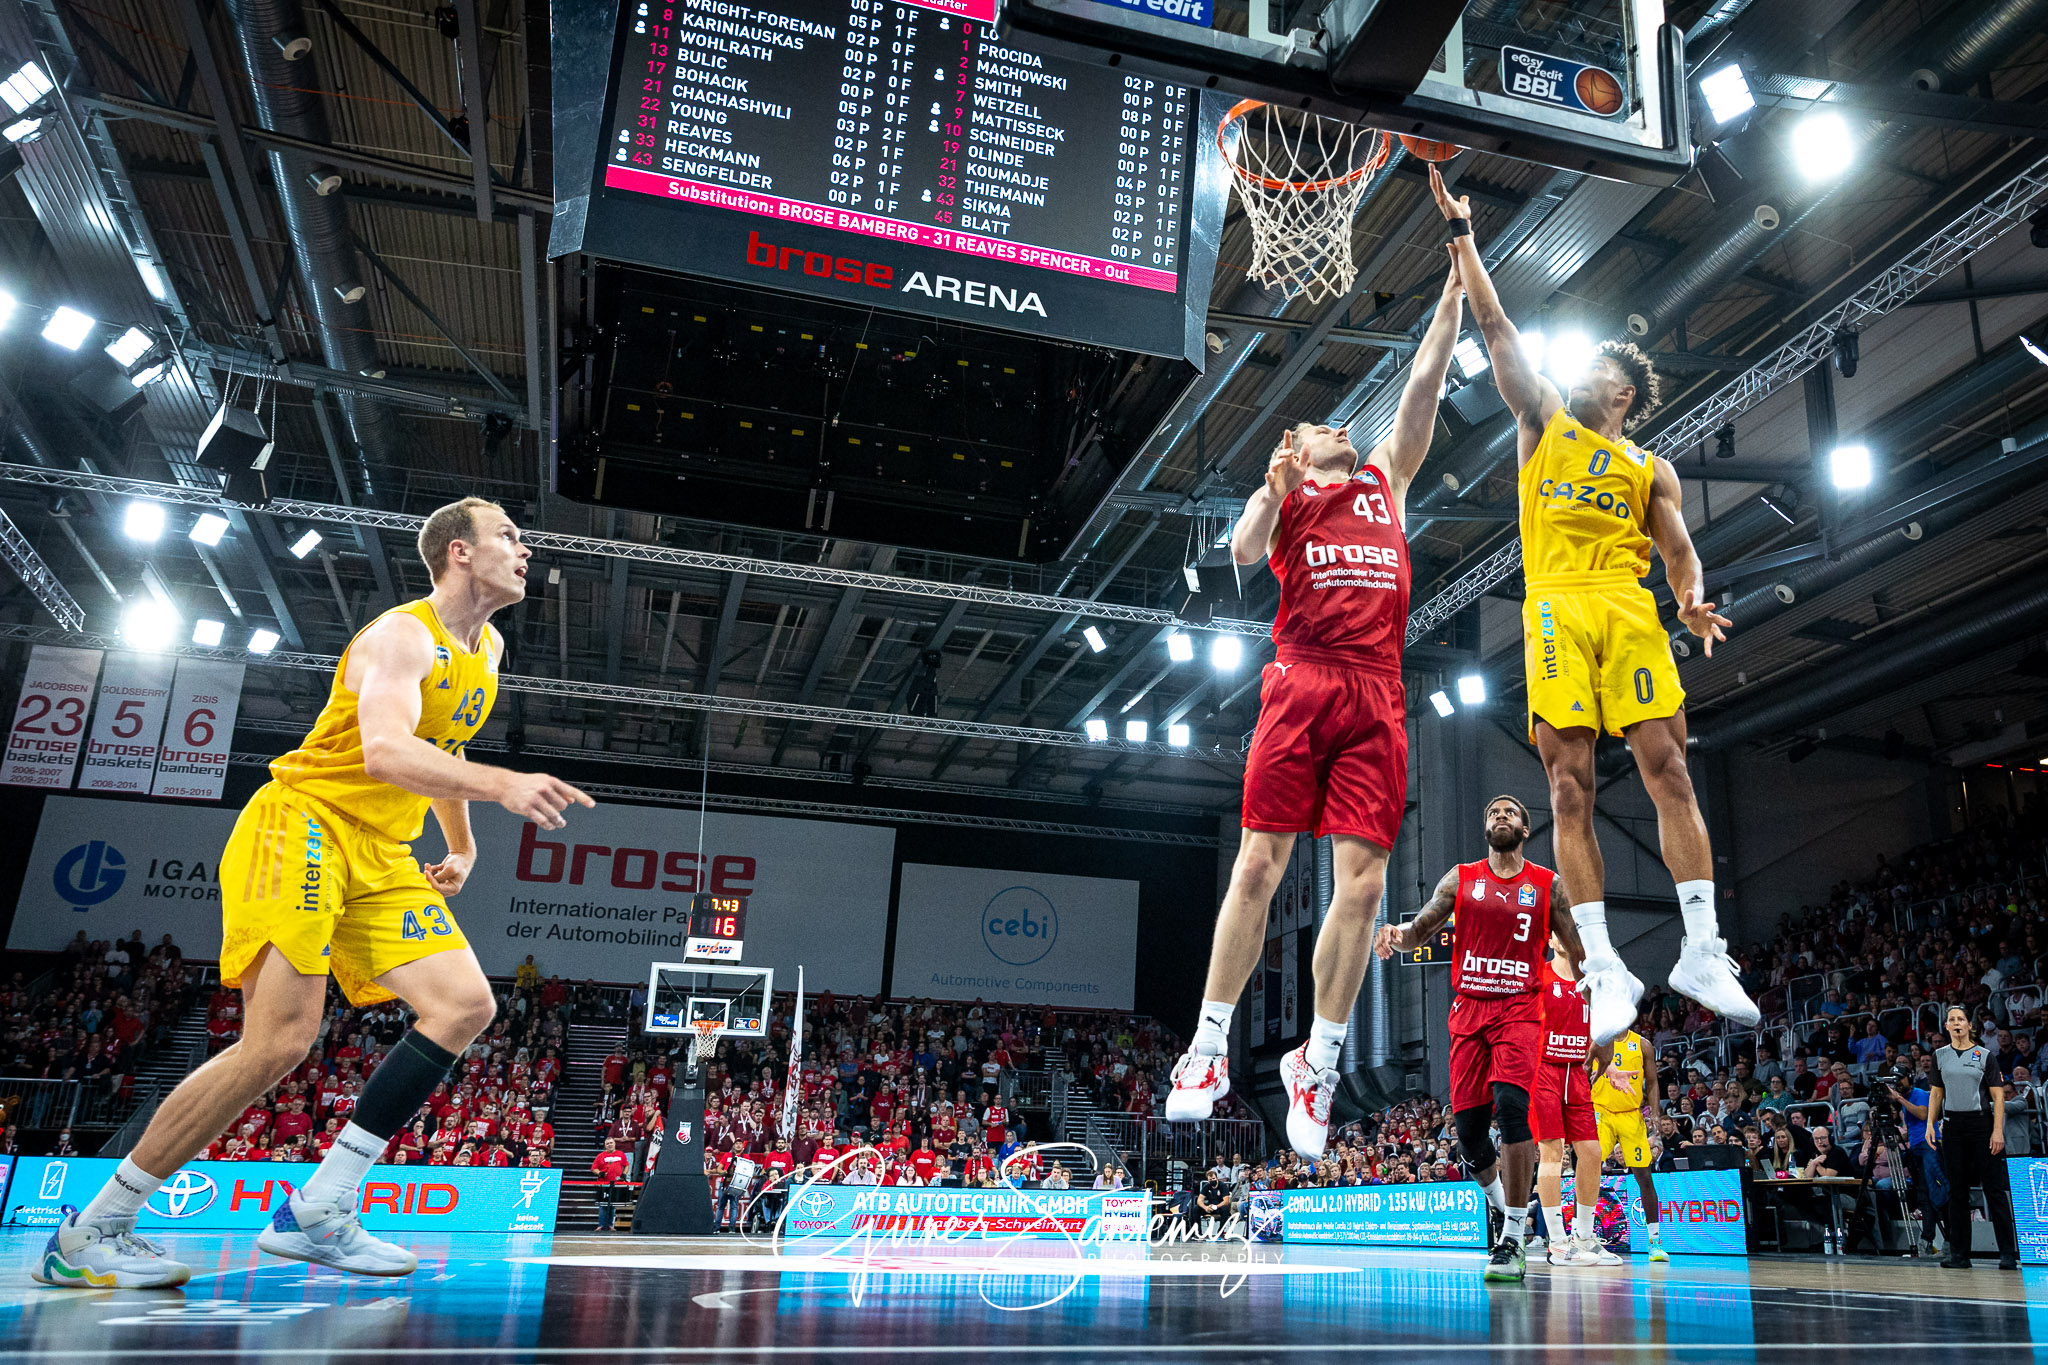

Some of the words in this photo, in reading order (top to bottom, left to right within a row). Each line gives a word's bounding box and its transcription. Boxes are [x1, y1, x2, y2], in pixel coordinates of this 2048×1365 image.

[664, 9, 672, 20] 8
[683, 13, 803, 49] KARINIAUSKAS
[686, 0, 835, 39] WRIGHT-FOREMAN
[964, 23, 971, 34] 0
[651, 42, 668, 56] 13
[678, 48, 727, 69] BULIC
[653, 25, 668, 38] 11
[681, 30, 772, 61] WOHLRATH
[963, 40, 968, 51] 1
[979, 44, 1042, 68] PROCIDA
[648, 61, 666, 74] 17
[676, 66, 748, 92] BOHACIK
[958, 74, 966, 85] 3
[975, 78, 1021, 97] SMITH
[960, 57, 968, 68] 2
[978, 60, 1066, 90] MACHOWSKI
[1527, 66, 1564, 81] Credit
[643, 78, 661, 92] 21
[673, 85, 791, 119] CHACHASHVILI
[1512, 73, 1564, 102] BBL
[641, 96, 660, 111] 22
[671, 102, 727, 124] YOUNG
[957, 90, 965, 101] 7
[974, 94, 1041, 119] WETZELL
[638, 115, 656, 128] 31
[668, 120, 732, 144] REAVES
[955, 108, 962, 119] 9
[972, 111, 1064, 141] MATTISSECK
[636, 133, 655, 147] 33
[665, 138, 760, 168] HECKMANN
[945, 123, 961, 136] 10
[970, 129, 1054, 156] SCHNEIDER
[944, 140, 960, 153] 19
[969, 146, 1024, 167] OLINDE
[632, 152, 652, 165] 43
[662, 157, 772, 189] SENGFELDER
[829, 189, 846, 203] 00
[851, 193, 861, 205] P
[875, 198, 883, 210] 0
[888, 200, 898, 212] F
[940, 158, 956, 171] 21
[967, 163, 1048, 190] KOUMADJE
[938, 175, 956, 188] 32
[965, 180, 1044, 206] THIEMANN
[936, 193, 954, 206] 43
[963, 198, 1010, 218] SIKMA
[668, 182, 773, 213] Substitution:
[779, 203, 834, 224] BROSE
[839, 214, 918, 240] BAMBERG
[934, 232, 950, 246] 31
[956, 236, 1016, 258] REAVES
[1020, 249, 1090, 273] SPENCER
[1105, 265, 1129, 280] Out
[934, 210, 952, 223] 45
[962, 215, 1010, 234] BLATT
[747, 231, 893, 289] brose
[902, 271, 1048, 317] ARENA
[1588, 449, 1611, 476] 0
[1352, 493, 1391, 525] 43
[1540, 478, 1630, 519] CAZOO
[1305, 540, 1399, 568] brose
[1313, 582, 1326, 590] der
[1369, 569, 1396, 580] Partner
[1541, 601, 1557, 681] interzero
[28, 680, 88, 693] JACOBSEN
[101, 685, 168, 698] GOLDSBERRY
[192, 694, 218, 704] ZISIS
[1634, 667, 1654, 704] 0
[14, 695, 85, 737] 23
[111, 700, 146, 738] 5
[451, 688, 485, 727] 43
[183, 708, 216, 747] 6
[9, 734, 77, 753] brose
[89, 738, 155, 757] brose
[161, 746, 227, 764] brose
[6, 751, 74, 765] baskets
[86, 755, 152, 769] baskets
[158, 762, 224, 778] bamberg
[163, 786, 212, 796] 2015-2019
[516, 822, 756, 896] brose
[402, 904, 452, 941] 43
[509, 897, 657, 922] Internationaler
[506, 922, 541, 939] der
[715, 917, 736, 937] 16
[988, 908, 1048, 939] cebi
[1513, 912, 1532, 942] 3
[1413, 946, 1431, 962] 27
[1462, 950, 1530, 978] brose
[931, 973, 1010, 988] Automotive
[1015, 977, 1099, 994] Components
[1500, 978, 1524, 987] Partner
[1614, 1053, 1622, 1067] 3
[1634, 1147, 1642, 1161] 3
[230, 1180, 459, 1214] HRID
[851, 1192, 891, 1211] ATB
[894, 1192, 1030, 1213] AUTOTECHNIK
[1288, 1195, 1327, 1213] COROLLA
[1329, 1194, 1342, 1212] 2.0
[1344, 1193, 1380, 1212] HYBRID
[1388, 1192, 1407, 1211] 135
[1409, 1191, 1426, 1211] kW
[1428, 1190, 1455, 1214] (184
[1457, 1189, 1478, 1215] PS)
[27, 1215, 60, 1224] Fahren
[516, 1213, 539, 1221] keine
[793, 1220, 836, 1230] TOYOTA
[1658, 1200, 1740, 1223] HYBRID
[508, 1222, 544, 1231] Ladezeit
